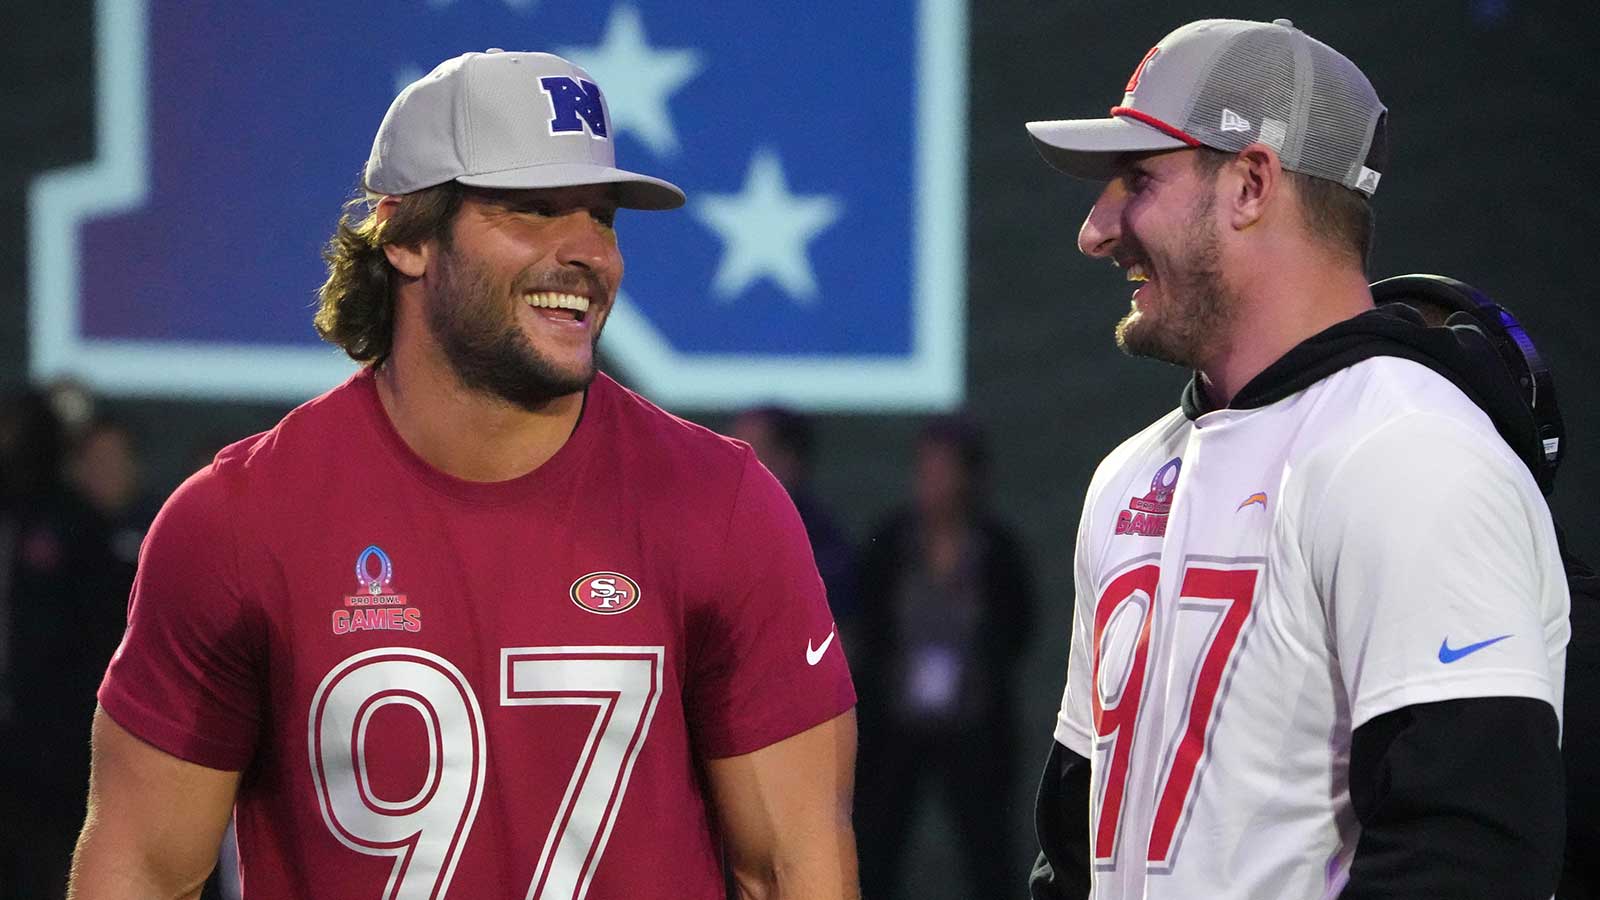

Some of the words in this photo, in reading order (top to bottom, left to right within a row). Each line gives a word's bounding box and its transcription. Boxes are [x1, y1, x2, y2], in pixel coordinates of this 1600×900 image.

[536, 75, 608, 140] N
[373, 595, 400, 604] BOWL
[590, 578, 627, 608] SF
[332, 607, 421, 635] GAMES
[1092, 552, 1269, 875] 97
[308, 646, 665, 900] 97
